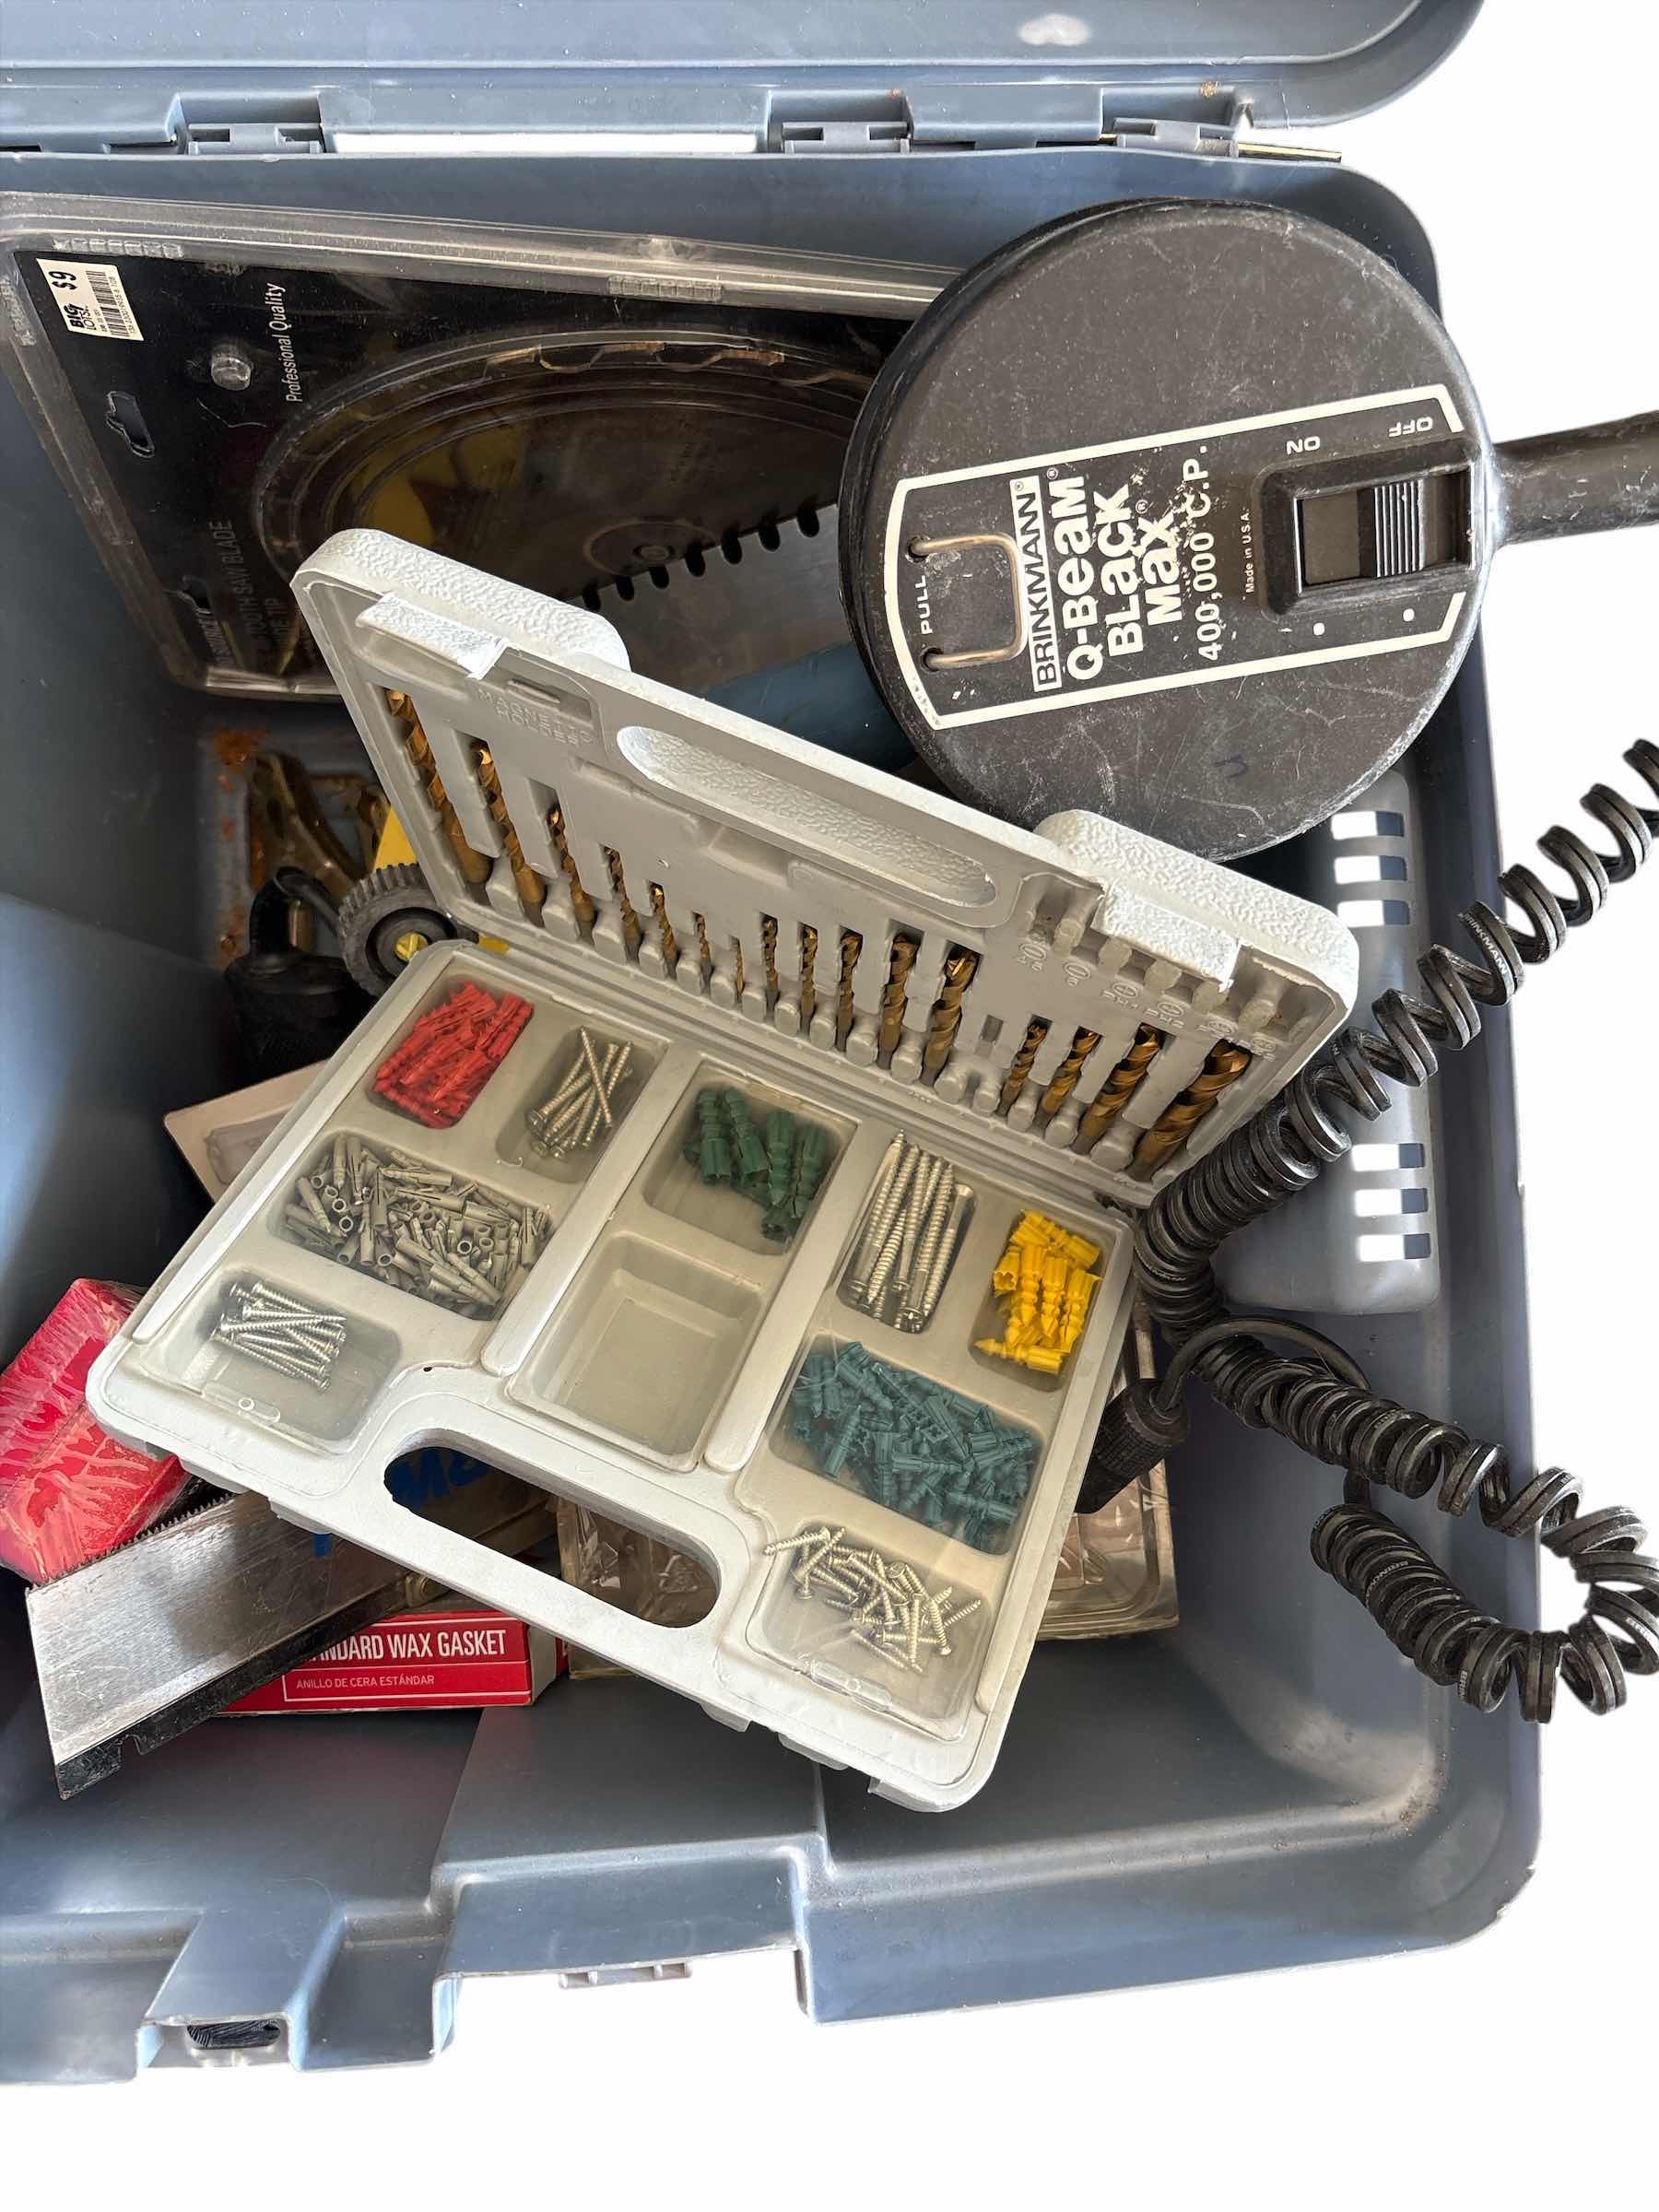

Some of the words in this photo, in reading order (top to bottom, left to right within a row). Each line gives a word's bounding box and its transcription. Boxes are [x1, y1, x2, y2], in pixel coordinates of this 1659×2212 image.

[48, 271, 77, 290] $9
[64, 303, 85, 328] BIG
[265, 282, 292, 331] Quality
[272, 334, 303, 403] Professional
[1388, 417, 1433, 438] OFF
[1286, 435, 1321, 455] ON
[1182, 445, 1212, 518] C.P.
[209, 520, 244, 564] BLADE
[1241, 509, 1253, 544] U.S.A.
[1243, 547, 1253, 559] in
[1017, 492, 1058, 686] BRINKMANN
[1244, 562, 1254, 593] Made
[914, 575, 933, 635] PULL
[1190, 532, 1222, 661] 400,000
[311, 1634, 384, 1661] NDARD
[387, 1632, 433, 1659] WAX
[437, 1629, 507, 1657] GASKET
[296, 1678, 333, 1689] ANILLO
[335, 1677, 348, 1688] DE
[349, 1677, 378, 1688] CERA
[380, 1673, 435, 1688] ESTÁNDAR
